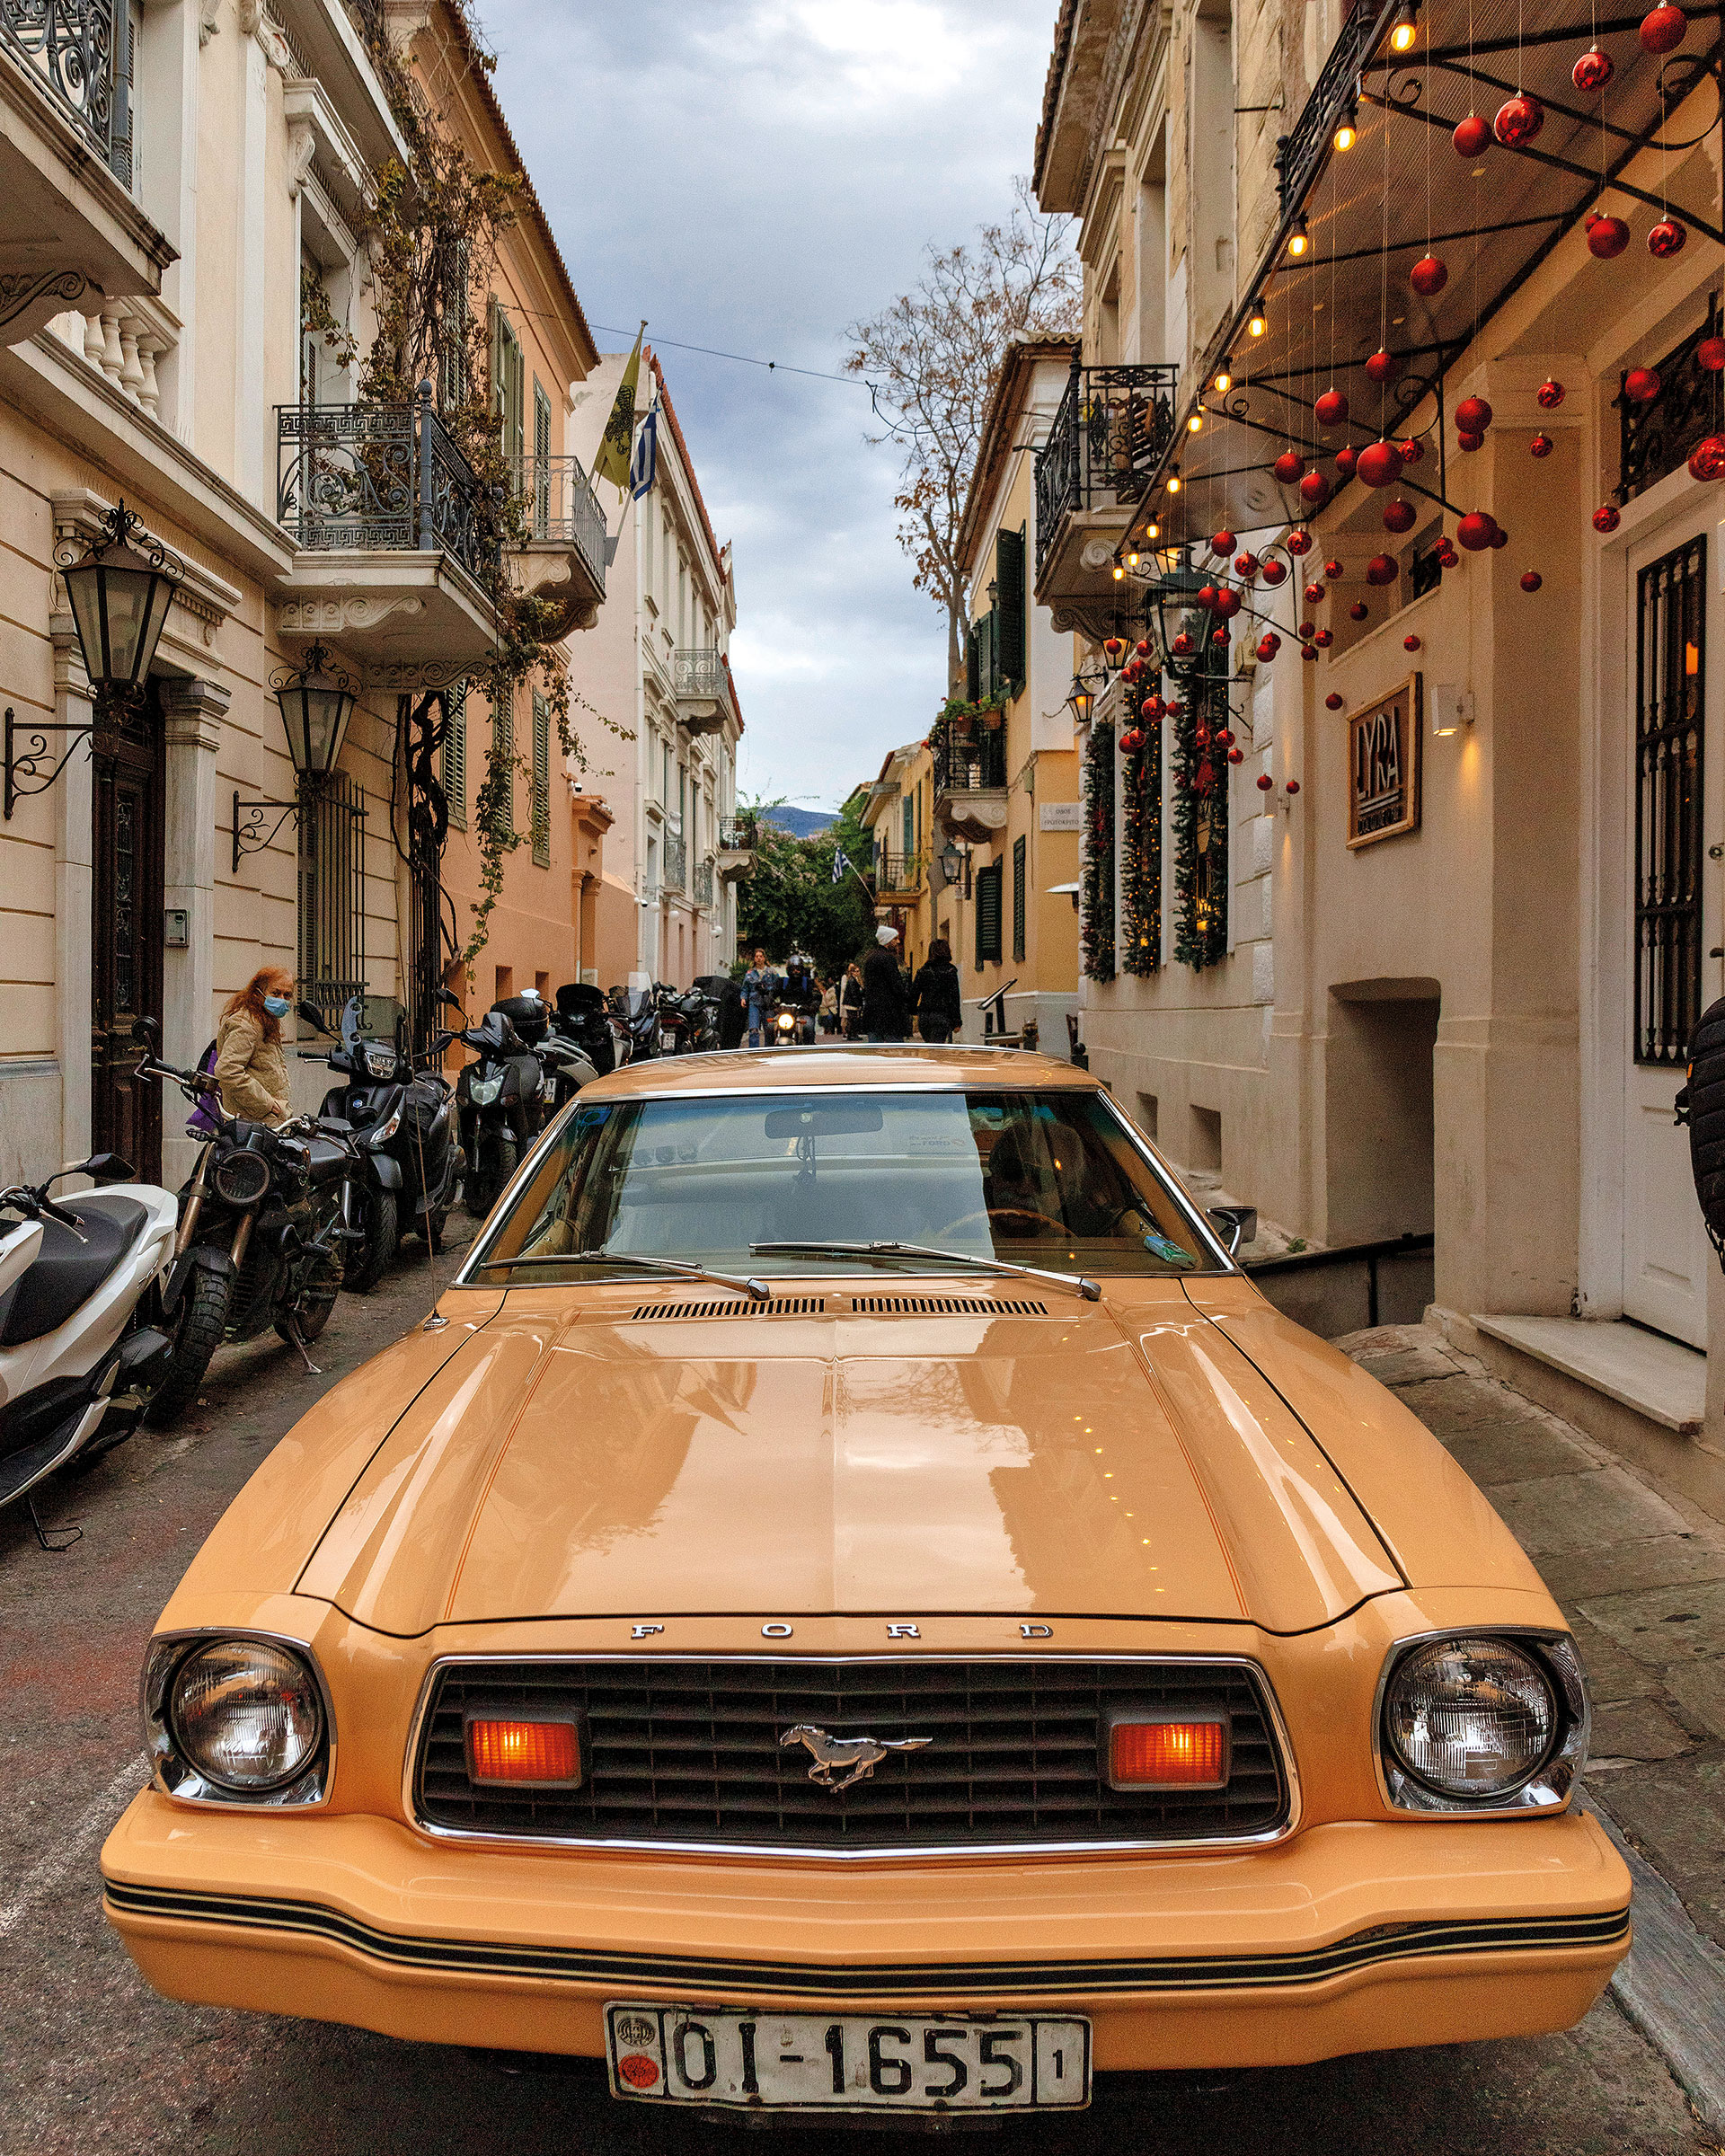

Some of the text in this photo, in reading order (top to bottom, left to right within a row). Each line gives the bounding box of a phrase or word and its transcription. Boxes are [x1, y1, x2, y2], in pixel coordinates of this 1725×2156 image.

[1357, 706, 1400, 800] LYRA
[631, 1623, 1054, 1639] FORD
[1052, 2049, 1064, 2080] 1
